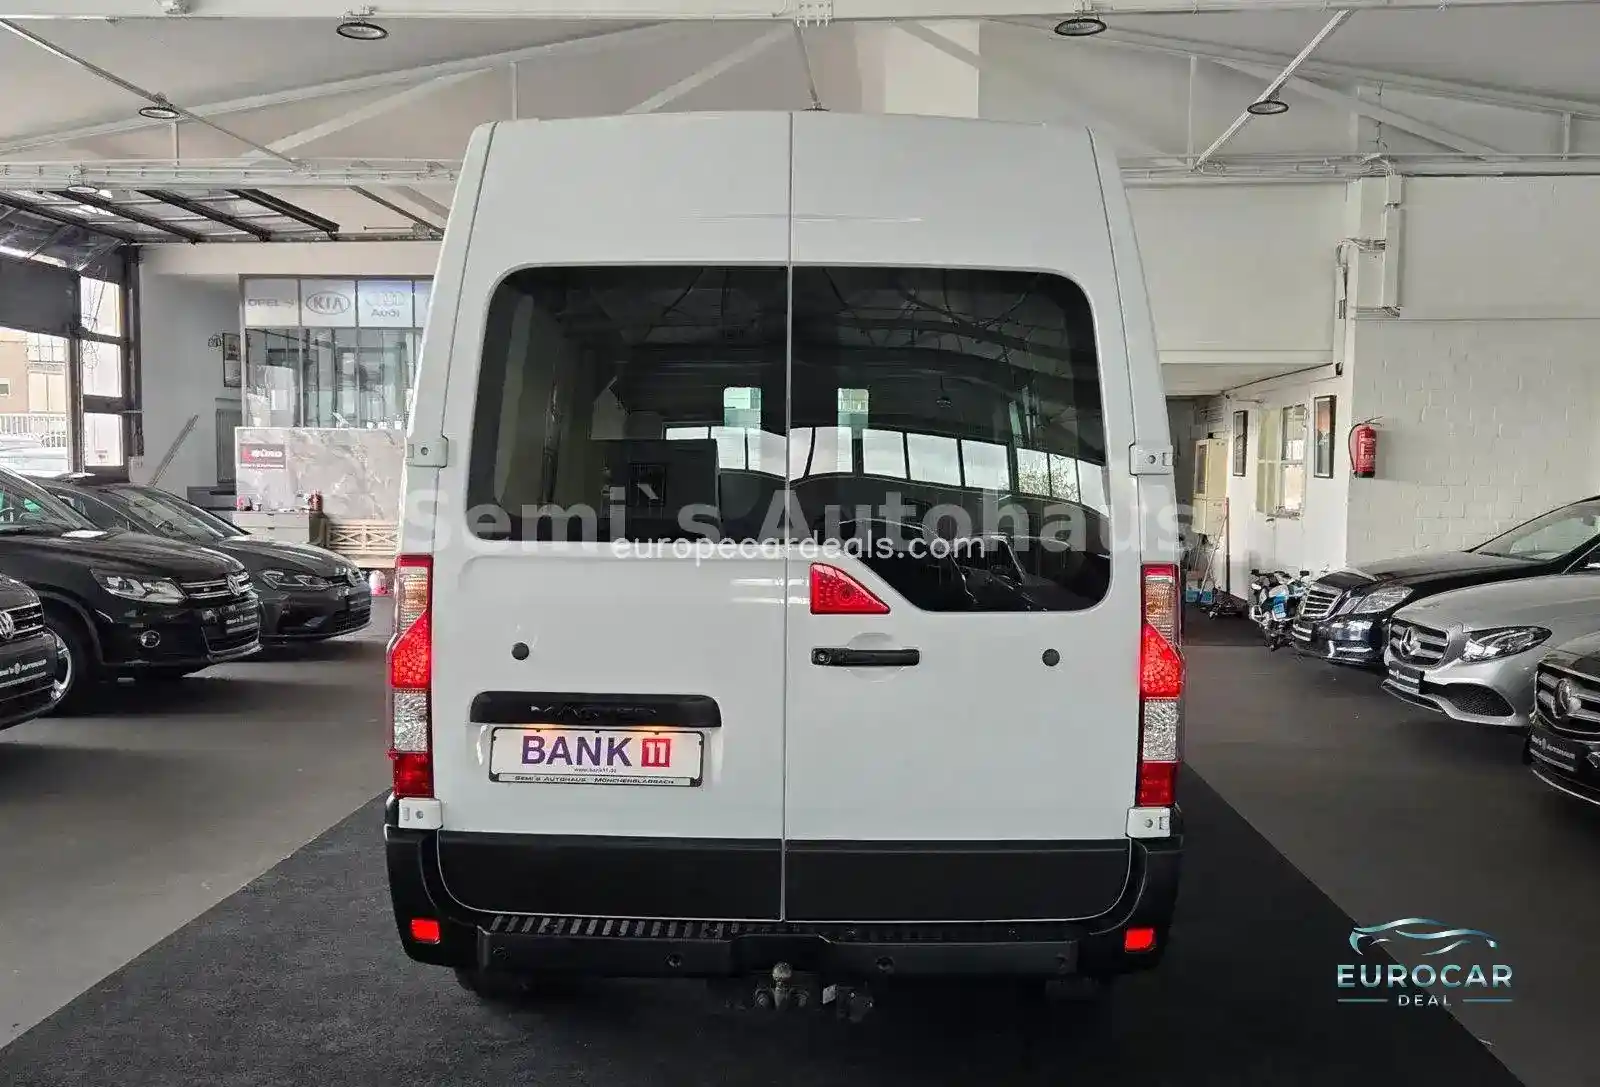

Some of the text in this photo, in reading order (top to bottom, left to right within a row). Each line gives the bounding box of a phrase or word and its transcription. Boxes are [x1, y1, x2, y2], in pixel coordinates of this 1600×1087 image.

[312, 296, 345, 310] KIA
[521, 735, 670, 767] BANK 11
